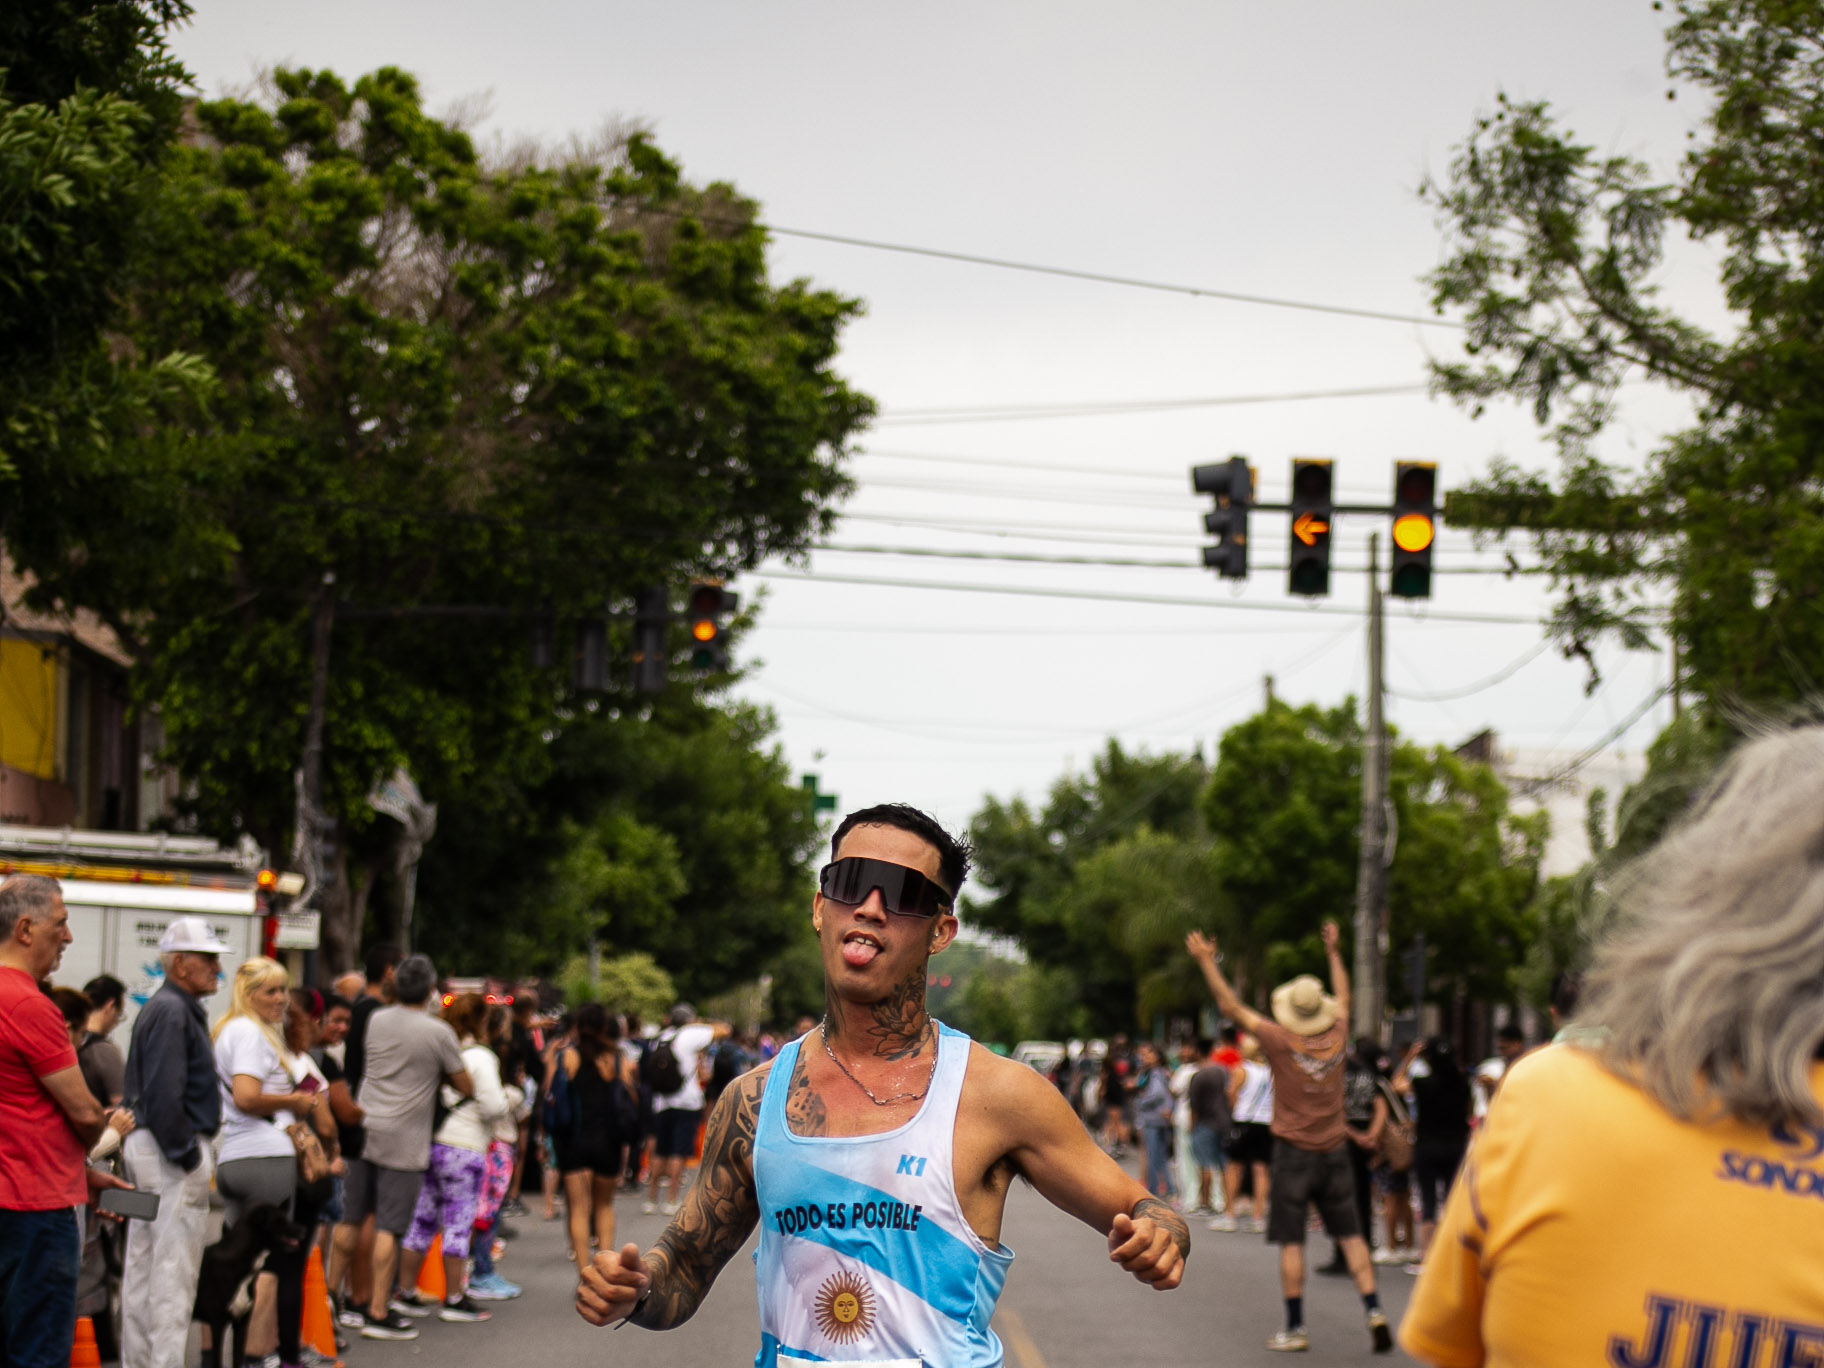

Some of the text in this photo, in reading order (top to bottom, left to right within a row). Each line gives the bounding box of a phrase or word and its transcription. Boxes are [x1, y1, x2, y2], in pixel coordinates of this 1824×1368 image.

[896, 1154, 927, 1177] K1
[775, 1201, 923, 1236] TODO ES POSIBLE
